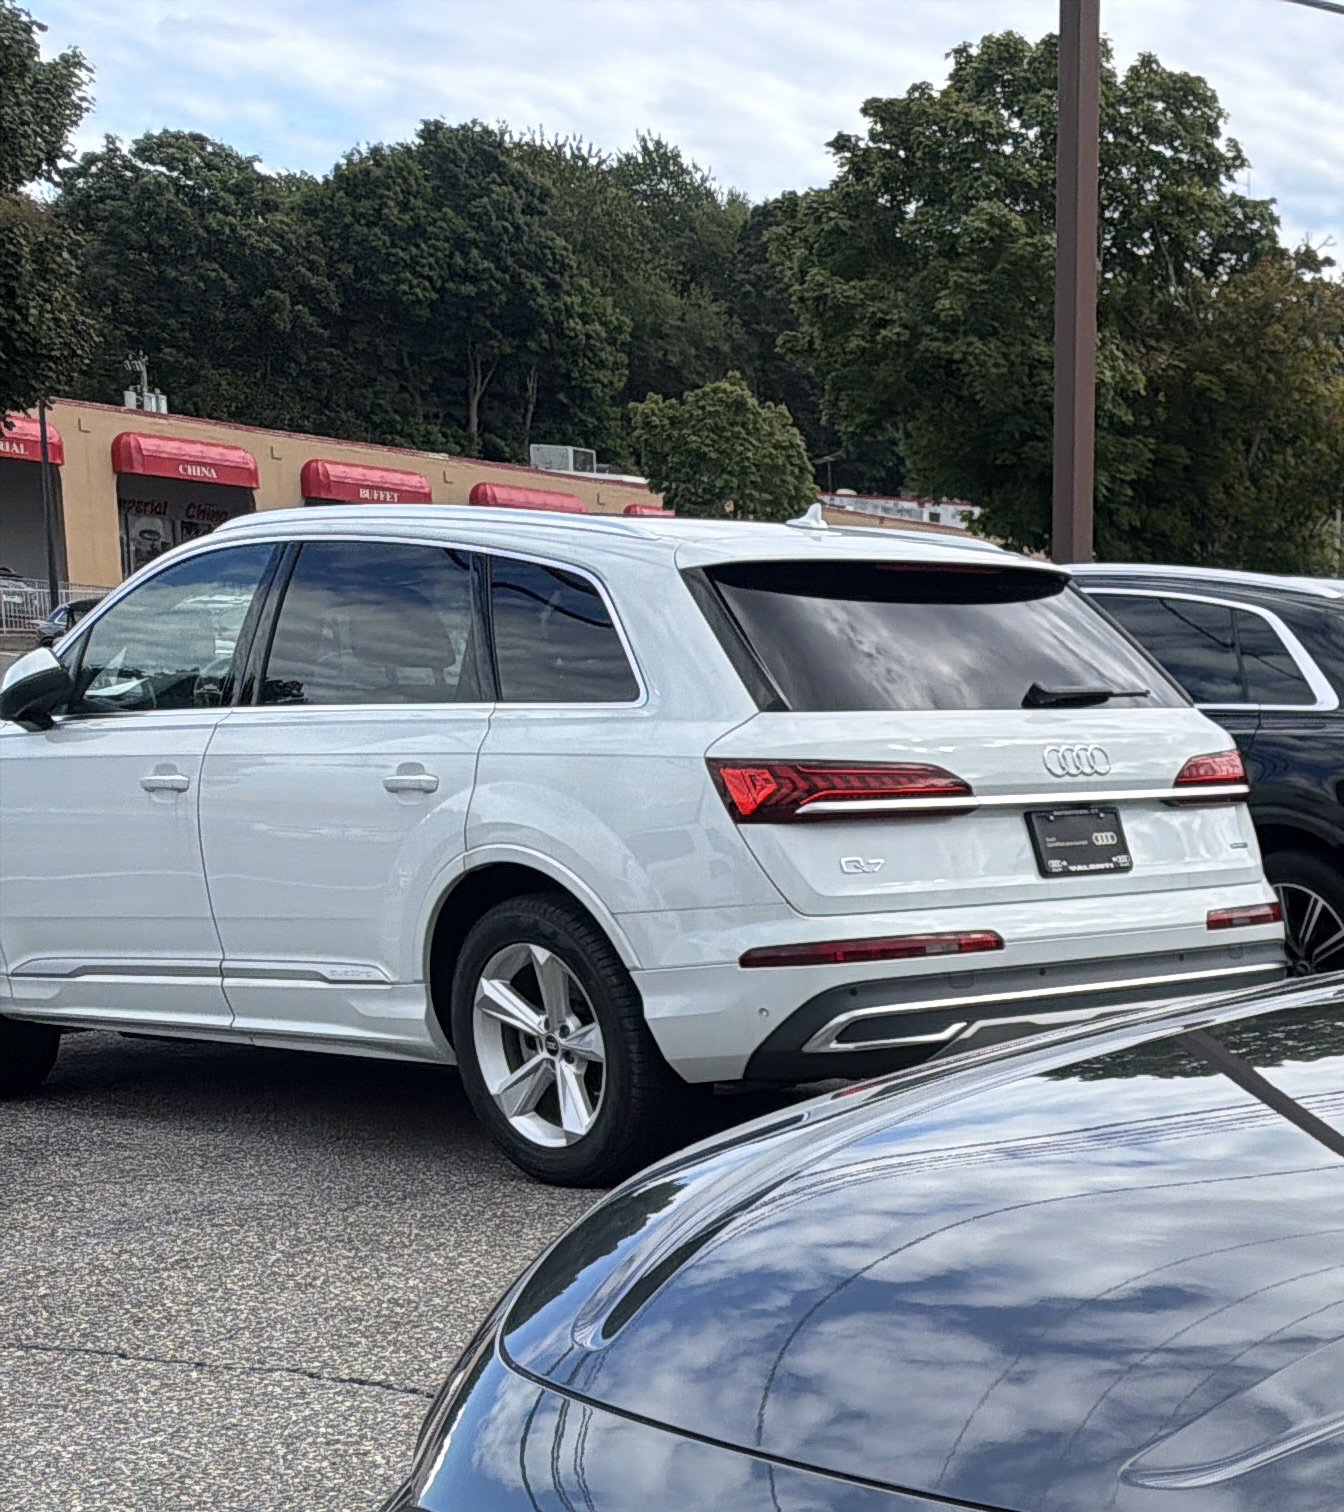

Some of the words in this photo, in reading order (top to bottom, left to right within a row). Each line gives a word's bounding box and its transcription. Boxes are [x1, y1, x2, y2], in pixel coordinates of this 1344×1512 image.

[178, 463, 218, 479] CHINA
[360, 488, 398, 502] BUFFET
[841, 857, 885, 873] Q7
